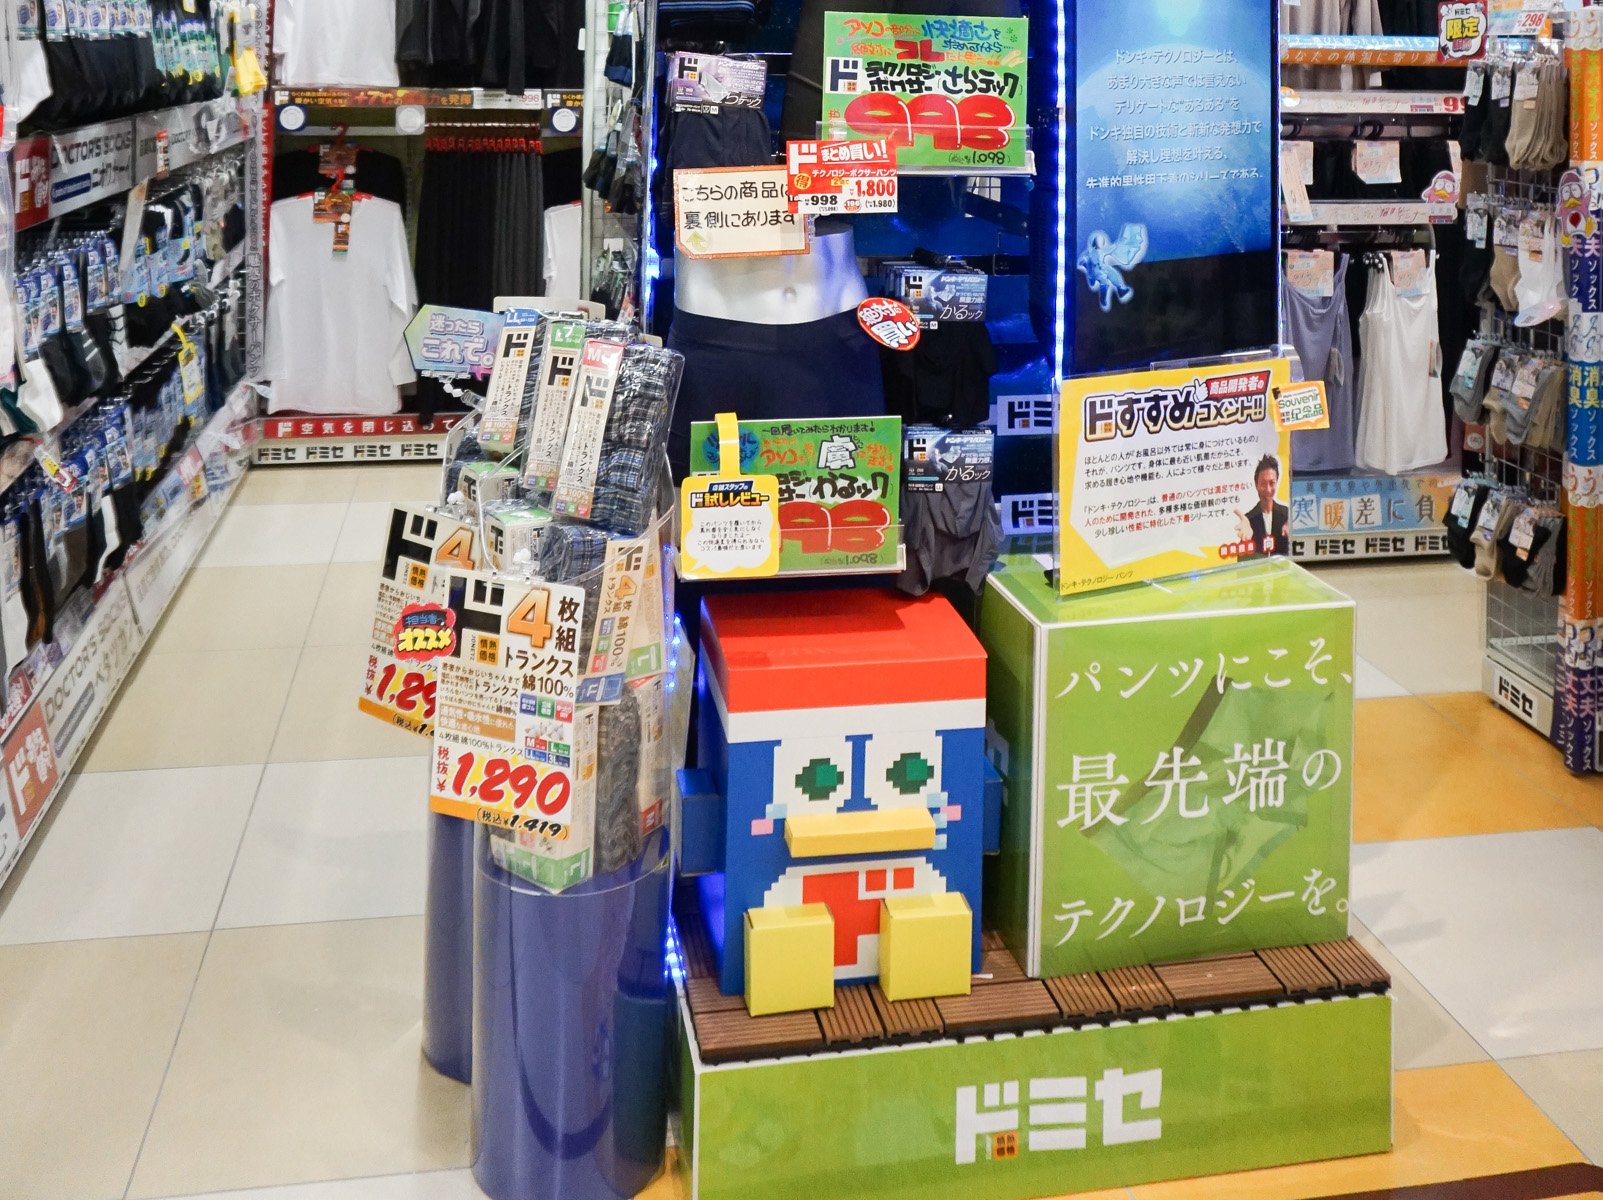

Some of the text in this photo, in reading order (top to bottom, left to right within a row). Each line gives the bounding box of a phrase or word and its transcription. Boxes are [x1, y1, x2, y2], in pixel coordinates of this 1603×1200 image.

[1445, 16, 1480, 41] 限定
[845, 93, 1016, 150] 998
[790, 139, 889, 175] ド まとめ買い!
[855, 179, 896, 198] 1,800
[683, 211, 796, 230] 裏側にあります
[429, 313, 484, 335] 迷ったら
[940, 304, 983, 319] かるック
[421, 336, 495, 367] これで。
[502, 333, 529, 358] ド
[547, 355, 575, 386] ド
[1278, 392, 1320, 409] Souvenir
[945, 465, 991, 481] かるック
[779, 499, 892, 555] 98
[382, 508, 438, 580] ド
[448, 575, 505, 659] ド
[398, 627, 453, 652] オススメ
[504, 646, 574, 678] トランクス
[1054, 637, 1353, 700] パンツにこそ、
[474, 679, 519, 699] トランクス
[521, 673, 574, 699] 綿100%
[1498, 675, 1534, 719] ドミセ
[452, 751, 571, 816] 1,290
[1055, 737, 1341, 829] 最先端の
[1054, 867, 1349, 948] テクノロジーを。
[955, 1067, 1163, 1165] ドミセ
